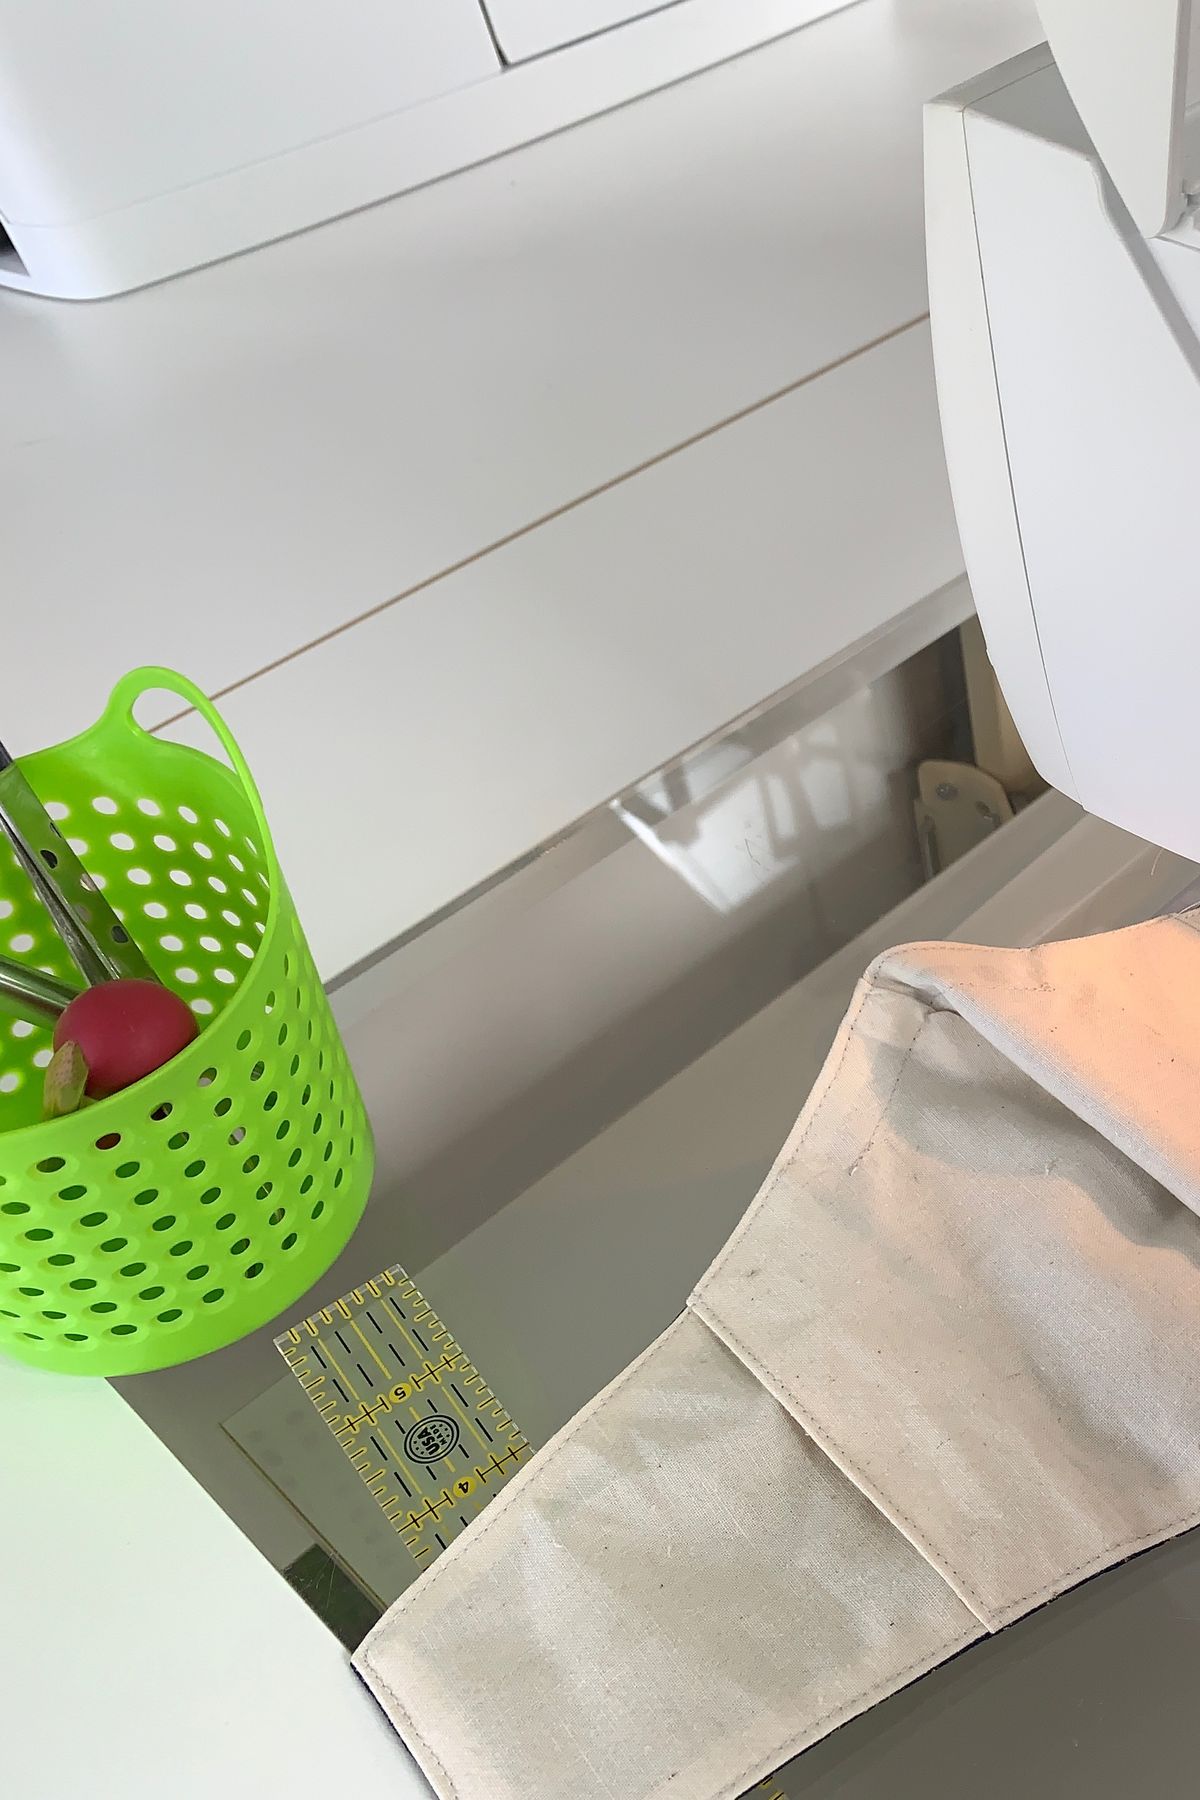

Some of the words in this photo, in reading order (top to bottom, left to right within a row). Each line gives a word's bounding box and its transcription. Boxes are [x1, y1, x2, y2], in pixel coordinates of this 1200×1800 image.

[394, 1387, 406, 1400] 5
[417, 1427, 440, 1455] USA
[430, 1424, 447, 1445] MADE
[458, 1481, 469, 1494] 4
